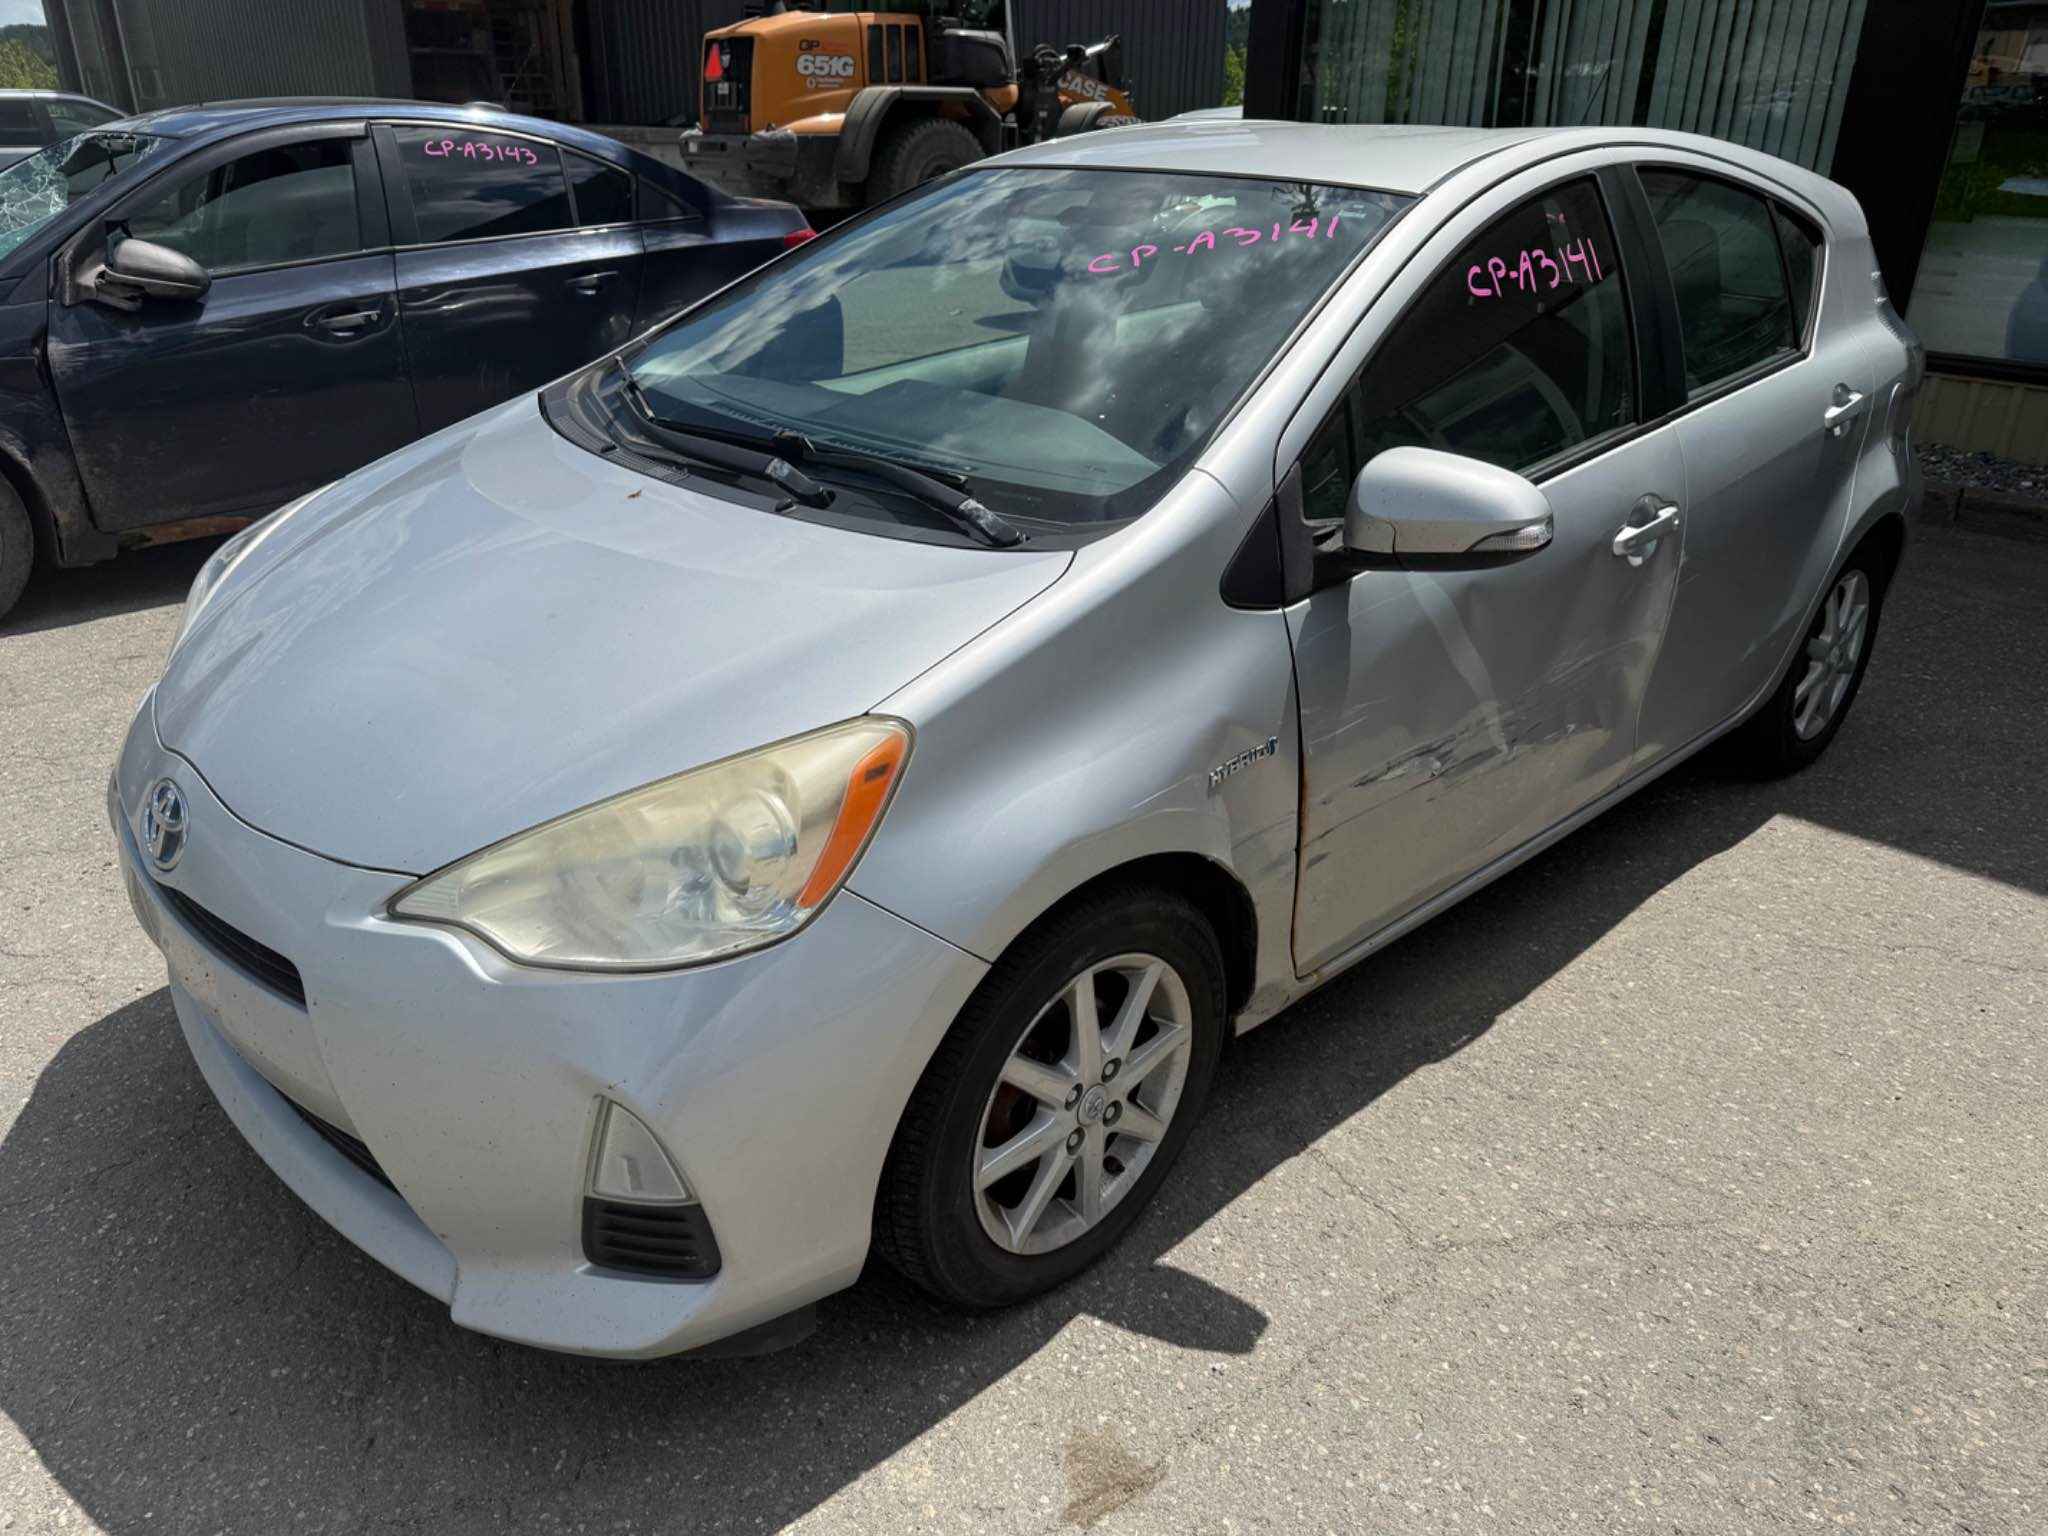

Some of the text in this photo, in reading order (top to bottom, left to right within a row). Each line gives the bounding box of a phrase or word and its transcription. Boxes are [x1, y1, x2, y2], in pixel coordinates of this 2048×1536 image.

[796, 53, 855, 76] 651G
[1057, 71, 1109, 101] CASE
[424, 140, 537, 165] CP-A3143
[1467, 238, 1602, 297] CP-A3141
